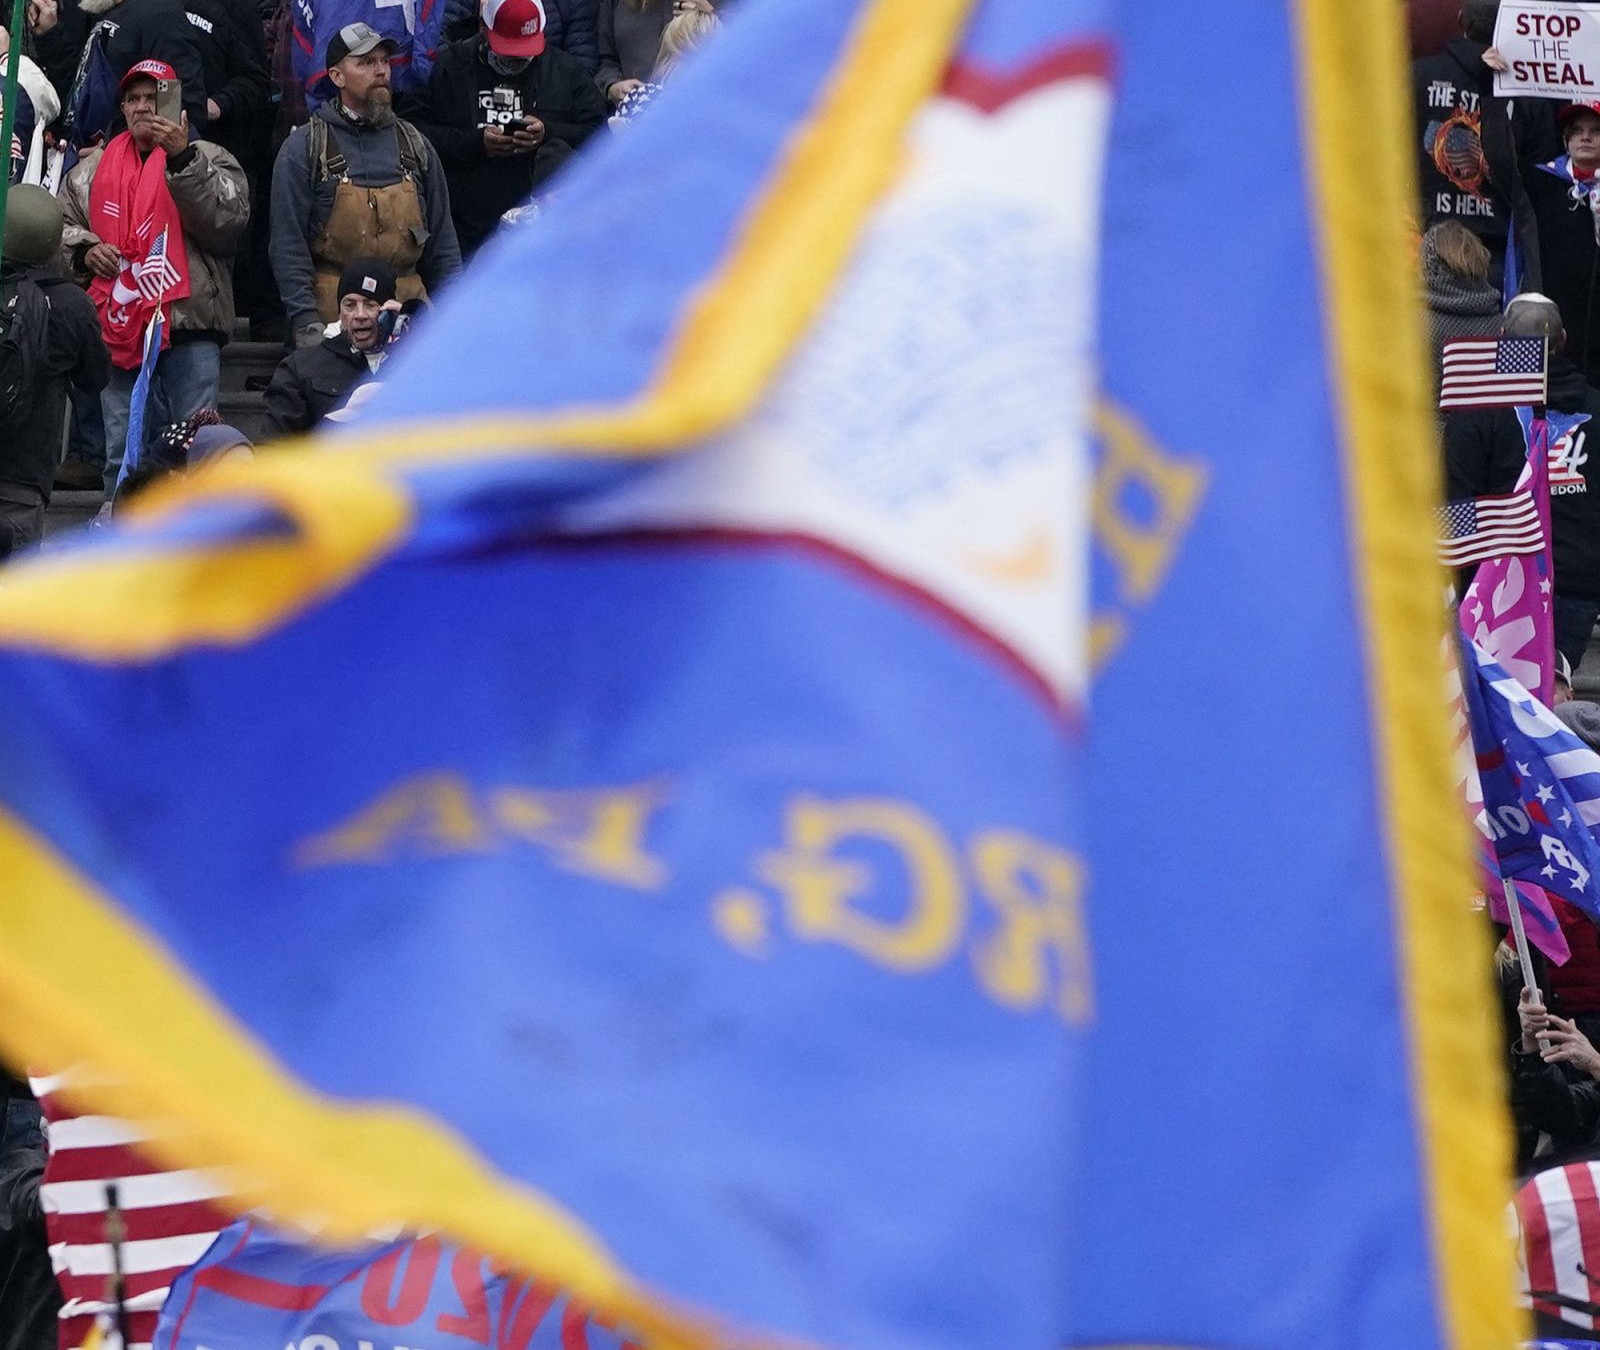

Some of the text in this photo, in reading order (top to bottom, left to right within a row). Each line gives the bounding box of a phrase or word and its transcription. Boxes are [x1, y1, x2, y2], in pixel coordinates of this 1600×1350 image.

[1516, 13, 1581, 37] STOP
[1528, 38, 1571, 61] THE
[1513, 61, 1594, 87] STEAL
[1427, 86, 1456, 108] THE
[1436, 192, 1495, 218] IS HERE
